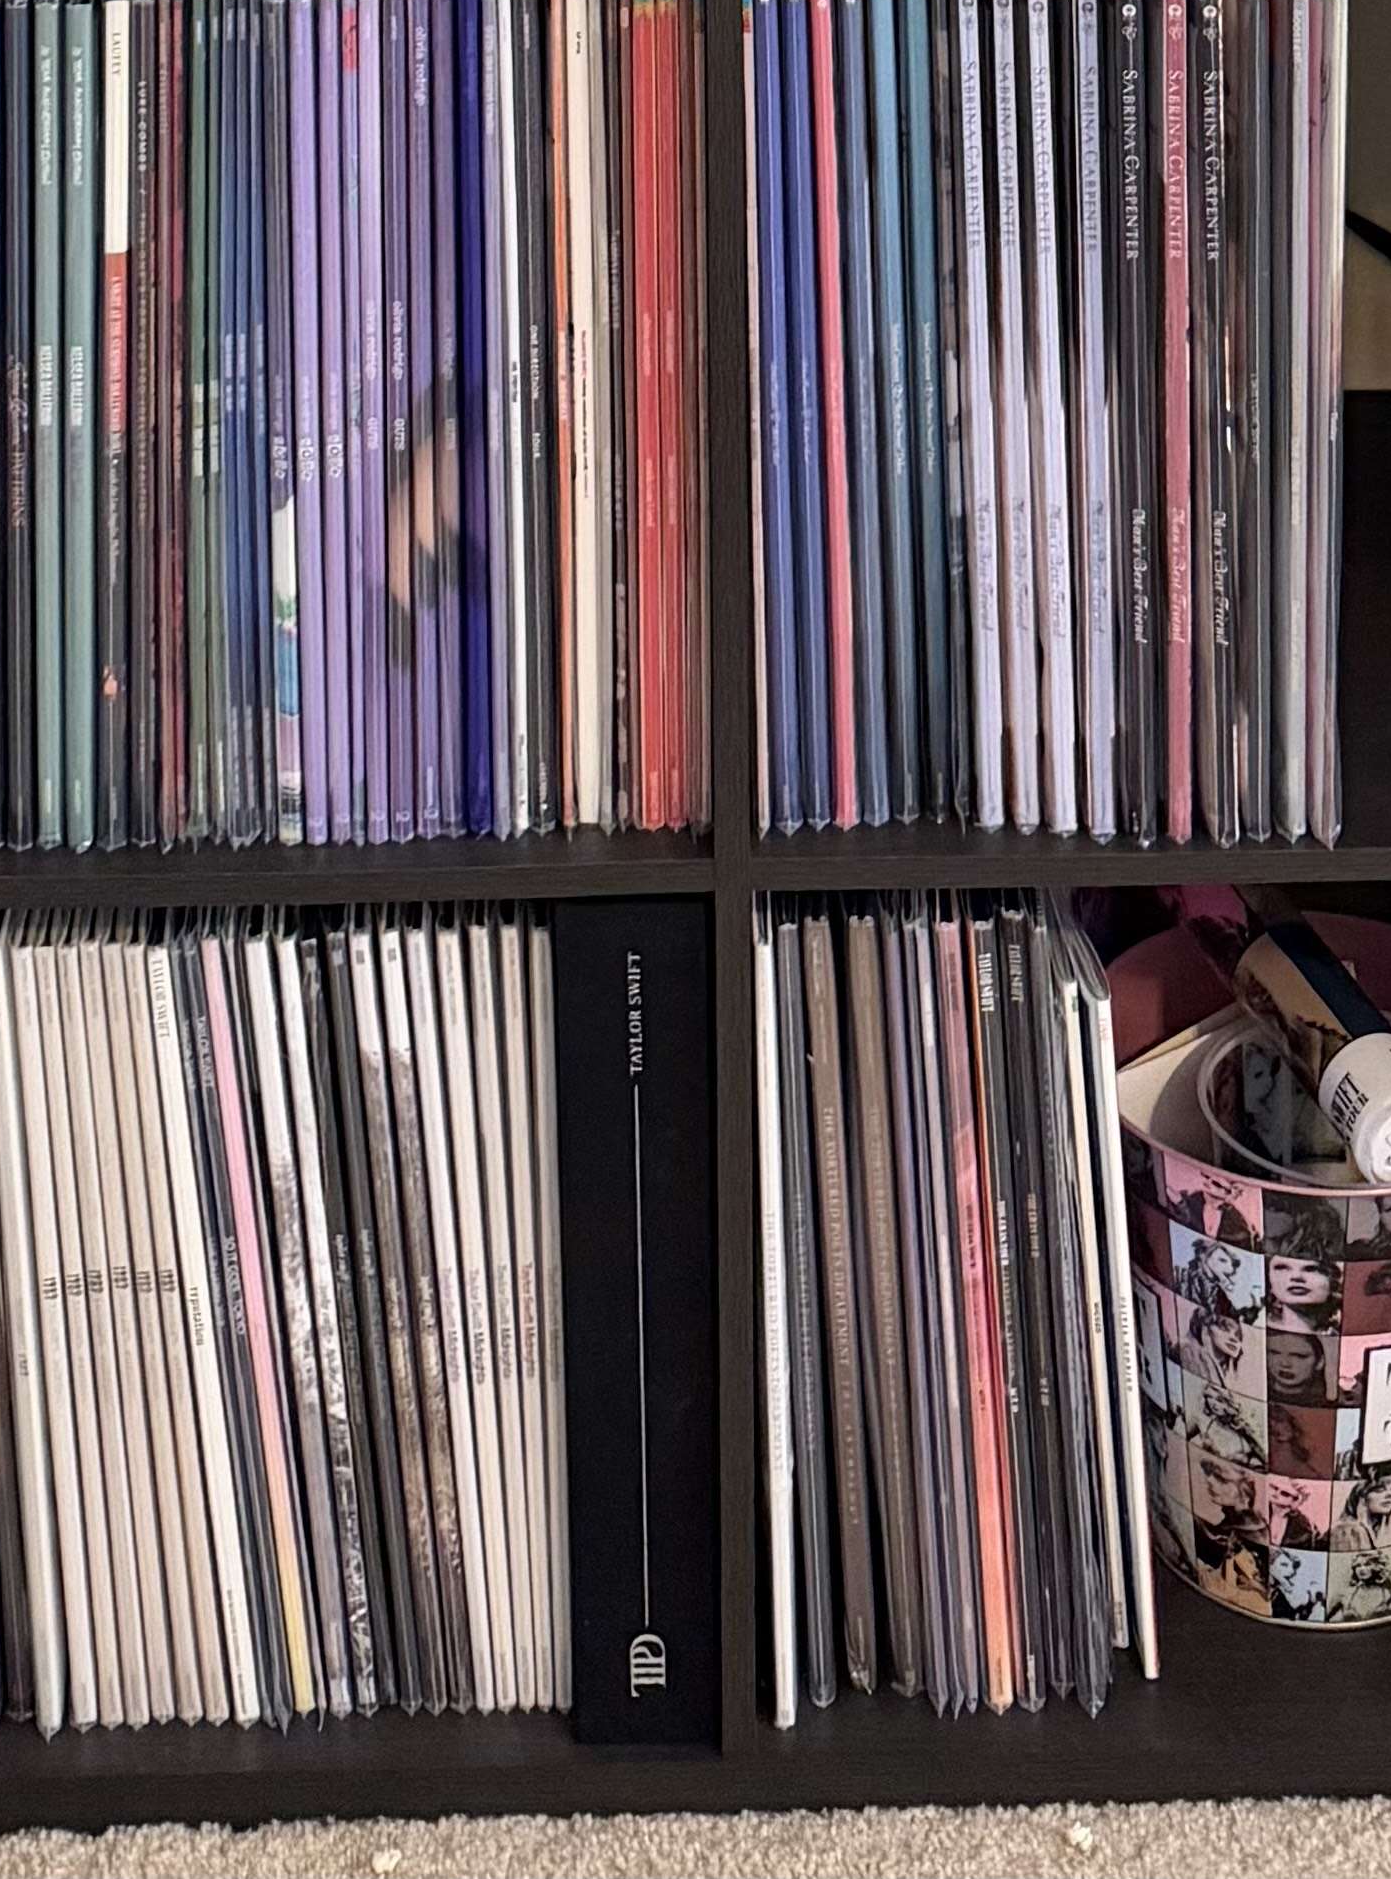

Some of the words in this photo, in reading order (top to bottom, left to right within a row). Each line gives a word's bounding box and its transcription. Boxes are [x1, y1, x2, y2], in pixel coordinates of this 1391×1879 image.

[112, 32, 121, 75] LAUFEY
[415, 26, 427, 61] olivia
[414, 63, 427, 106] rodrigo
[1121, 69, 1139, 151] SABRINA
[1167, 69, 1185, 150] SABRINA
[1201, 70, 1221, 151] SABRINA
[964, 146, 981, 249] CARPENTER
[999, 146, 1017, 249] CARPENTER
[1034, 150, 1053, 254] CARPENTER
[1082, 150, 1101, 253] CARPENTER
[1123, 155, 1141, 260] CARPENTER
[1167, 155, 1185, 260] CARPENTER
[1205, 156, 1221, 261] CARPENTER
[394, 418, 405, 451] GUTS
[11, 451, 25, 528] PATTERNS
[1213, 511, 1227, 556] Man's
[1131, 556, 1147, 590] Best
[1171, 556, 1187, 590] Best
[1213, 558, 1228, 592] Best
[1133, 595, 1148, 643] Friend
[1171, 594, 1187, 643] Friend
[1214, 598, 1230, 646] Friend
[627, 951, 643, 1005] SWIFT
[629, 1008, 643, 1076] TAYLOR
[822, 1107, 834, 1132] THE
[822, 1141, 839, 1217] TORTURED
[829, 1222, 842, 1267] POETS
[189, 1286, 206, 1347] reputation
[832, 1271, 849, 1367] DEPARTMENT
[447, 1329, 461, 1382] Midnights
[472, 1332, 486, 1385] Midnights
[500, 1327, 513, 1379] Midnights
[522, 1326, 537, 1378] Midnights
